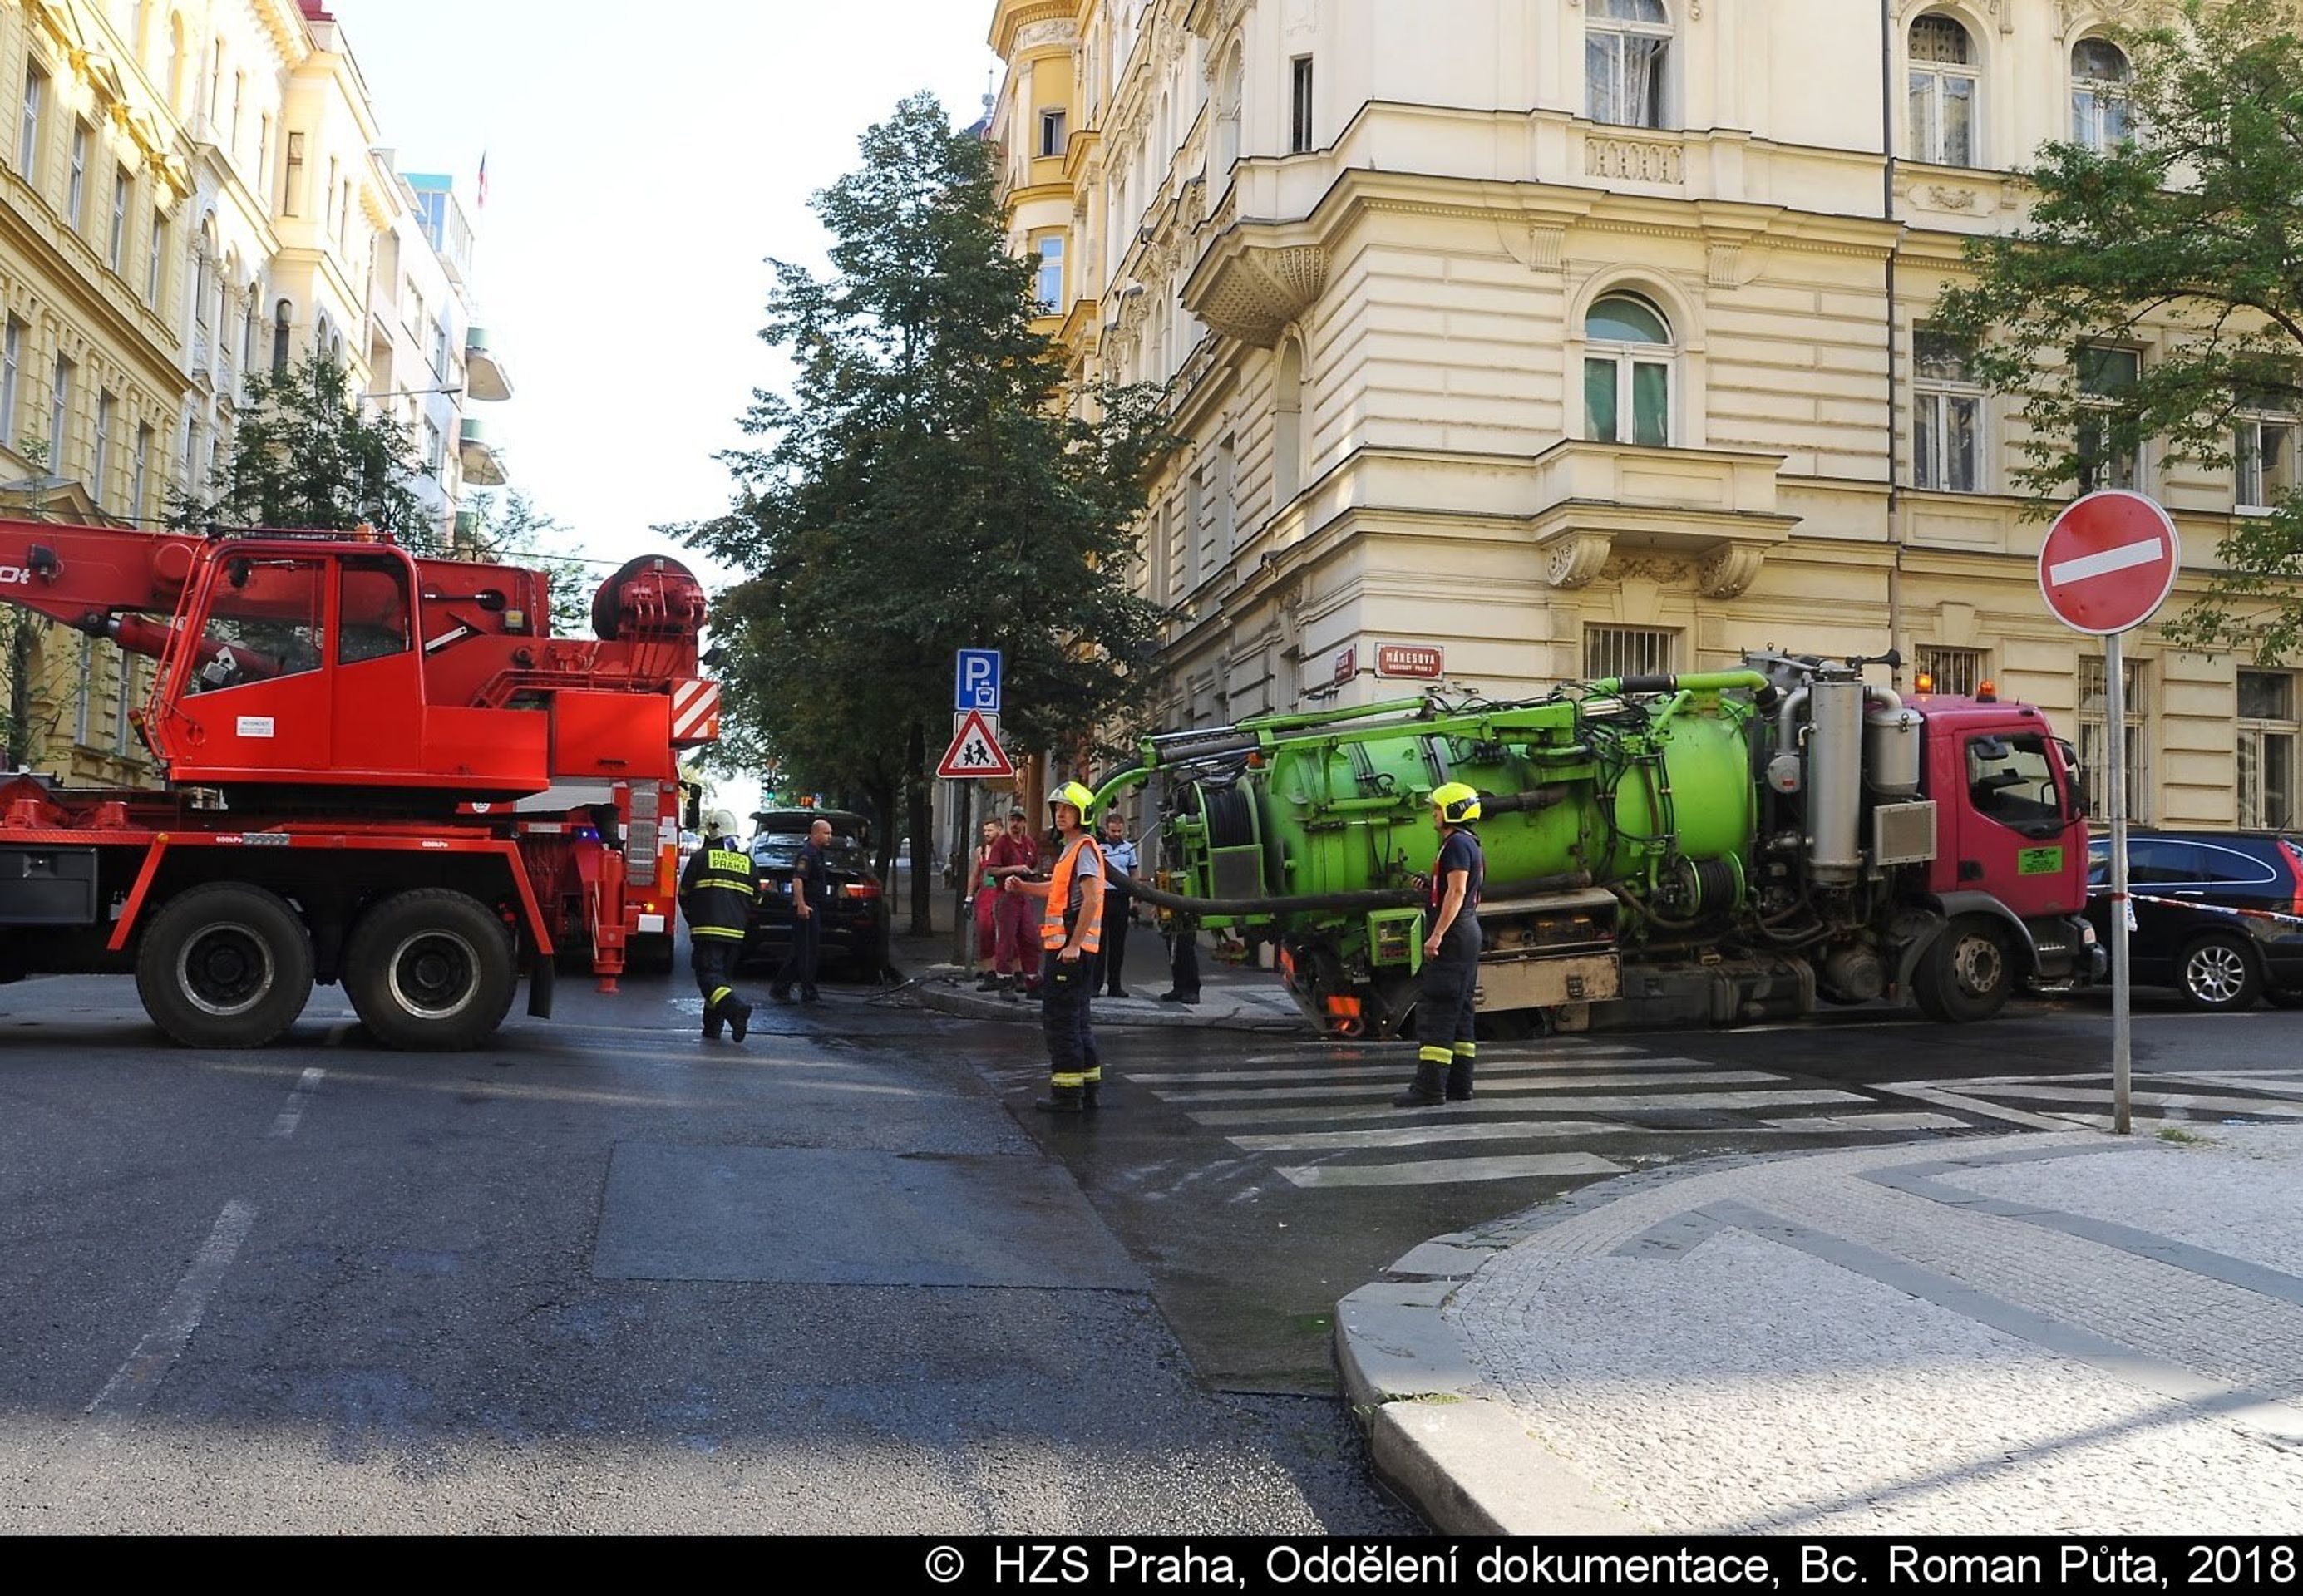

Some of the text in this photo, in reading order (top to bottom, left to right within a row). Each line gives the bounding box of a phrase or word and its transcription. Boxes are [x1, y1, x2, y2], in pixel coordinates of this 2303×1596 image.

[1386, 650, 1435, 664] MÁNESOVA
[966, 657, 991, 692] P
[713, 859, 746, 871] PRAHA
